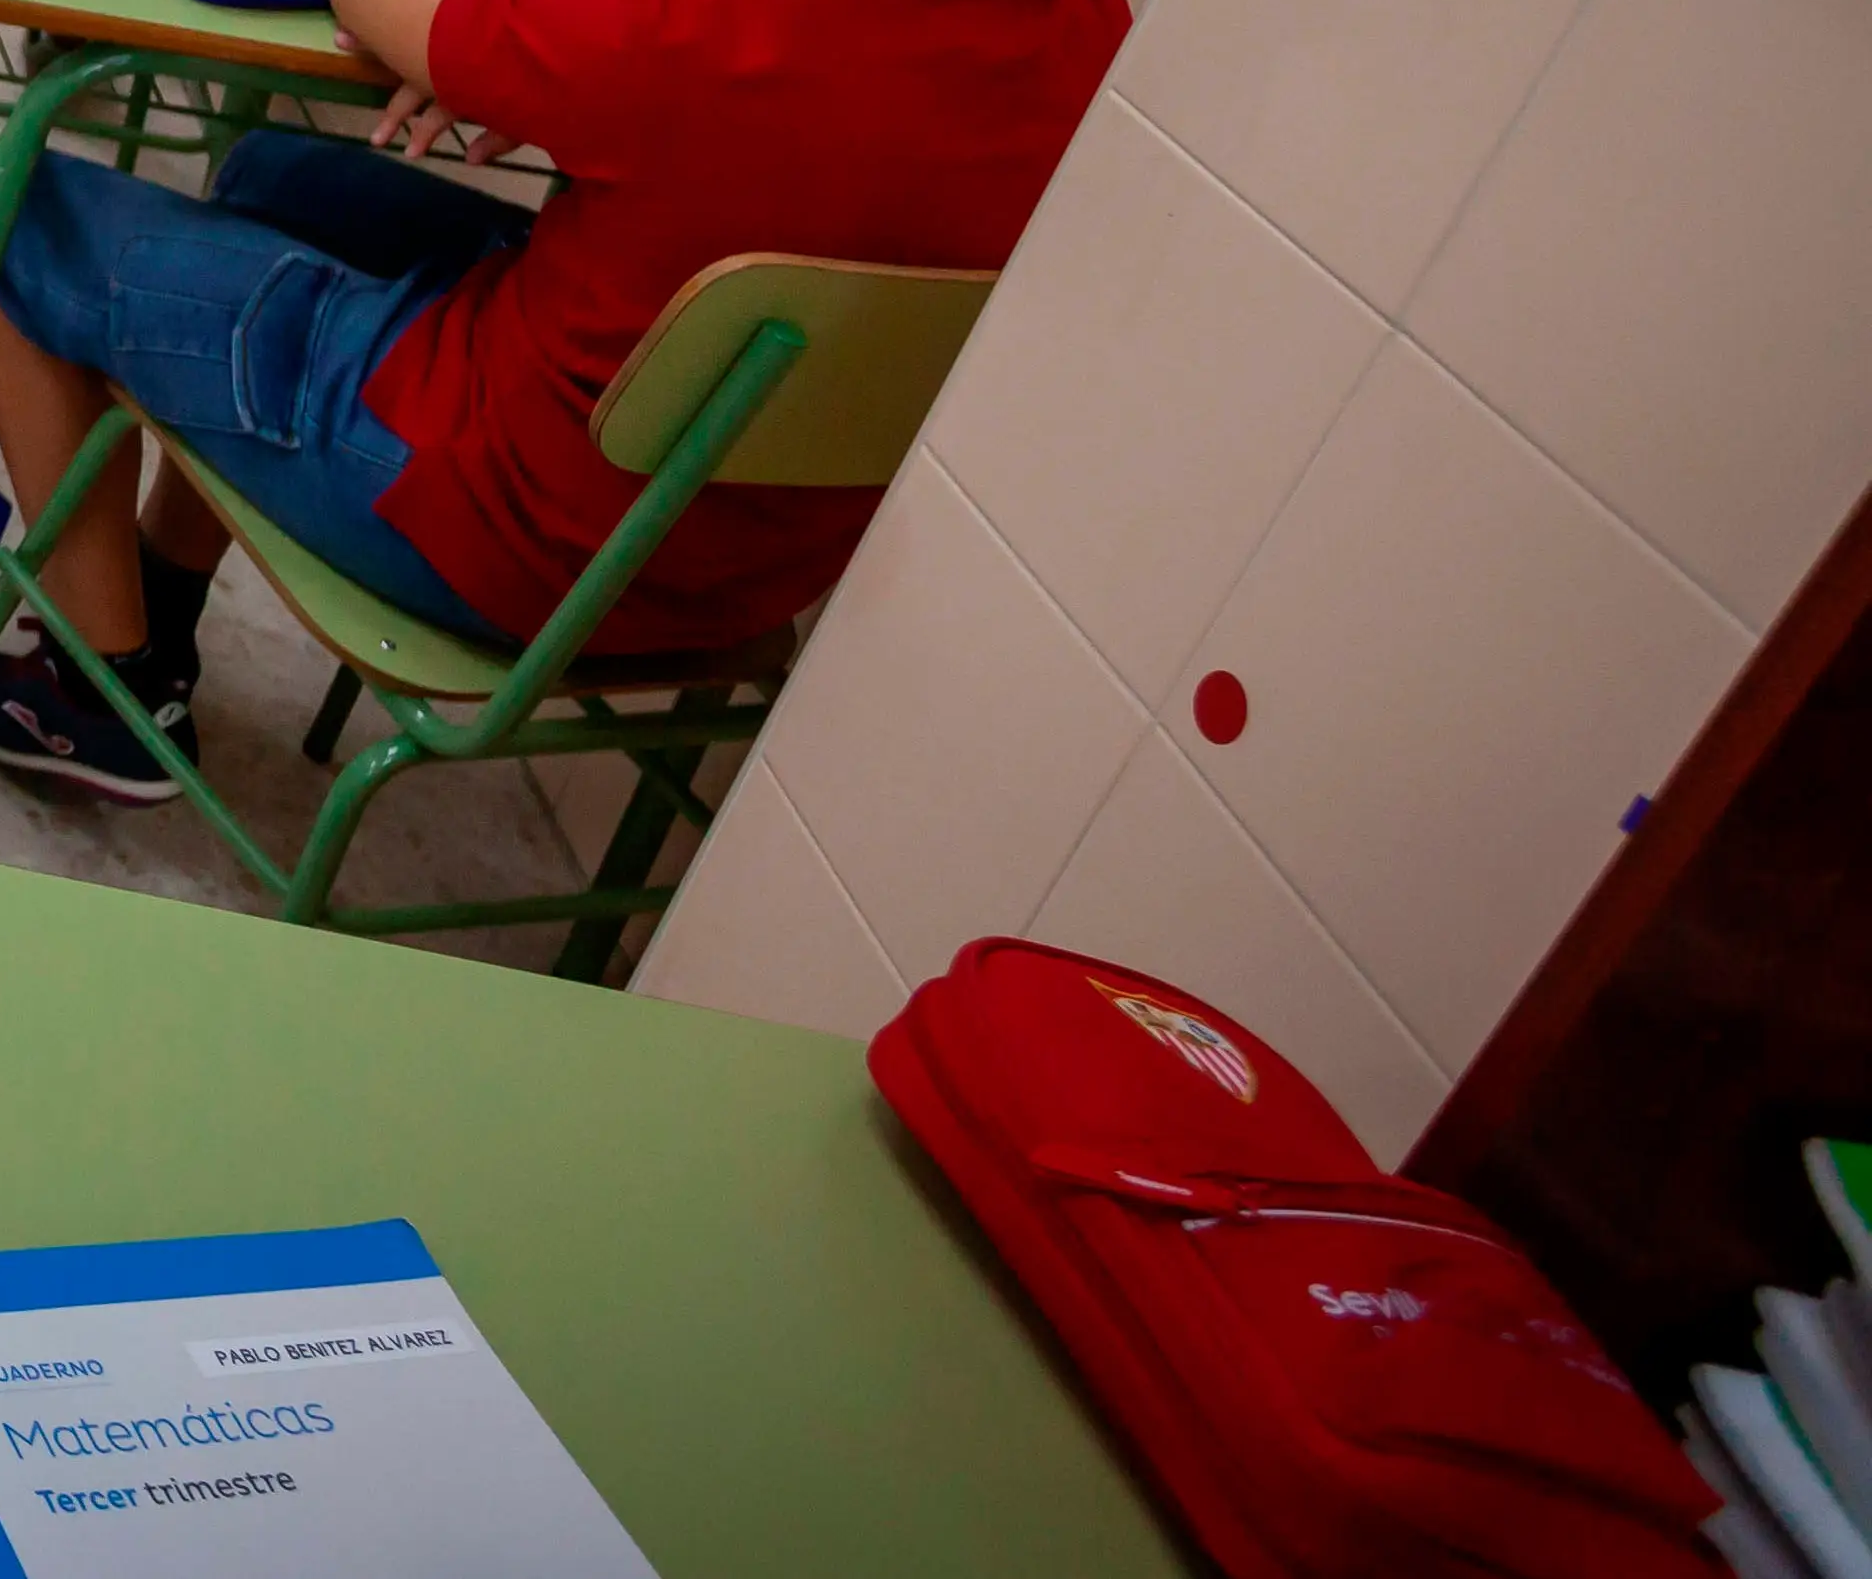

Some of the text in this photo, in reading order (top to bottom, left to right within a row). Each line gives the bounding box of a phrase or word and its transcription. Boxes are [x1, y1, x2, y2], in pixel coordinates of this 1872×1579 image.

[214, 1329, 454, 1367] PABLO BENITEZ ALVAREZ
[2, 1398, 335, 1461] Matemáticas
[35, 1468, 298, 1516] Tercer trimestre
